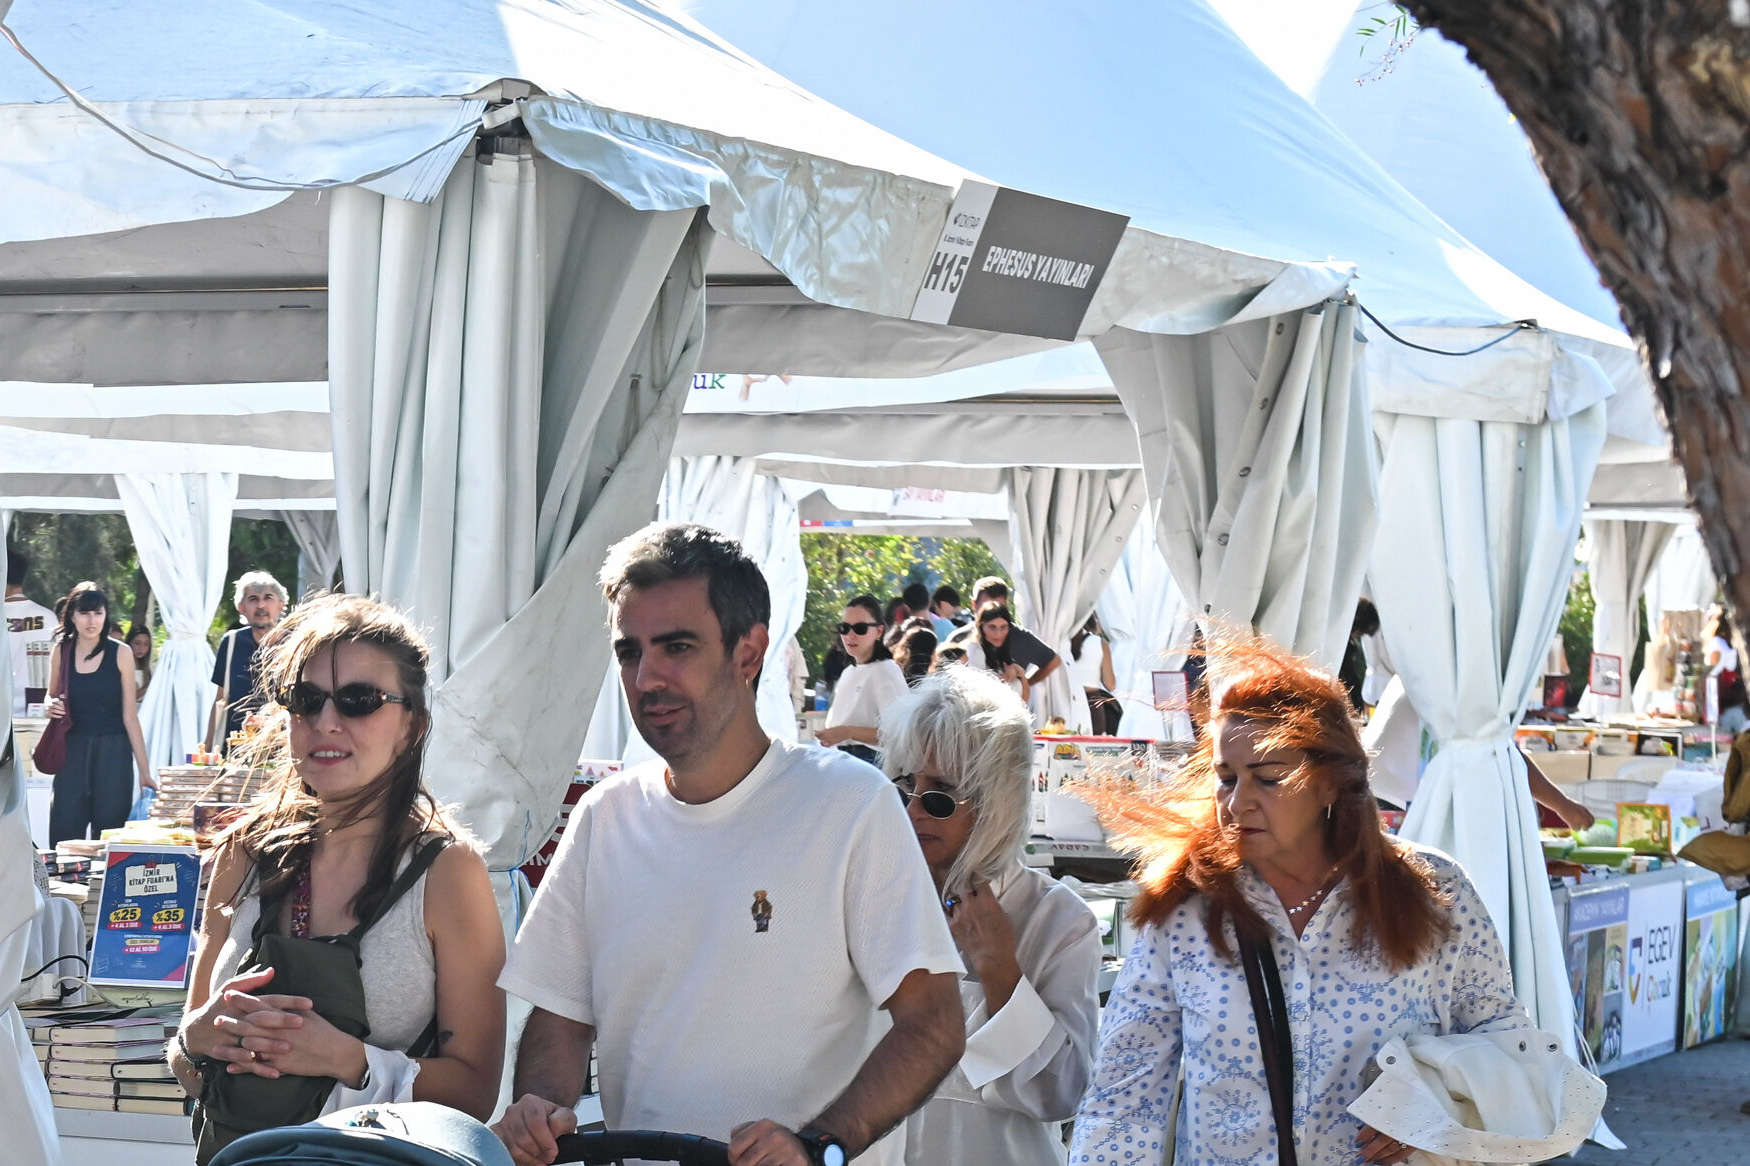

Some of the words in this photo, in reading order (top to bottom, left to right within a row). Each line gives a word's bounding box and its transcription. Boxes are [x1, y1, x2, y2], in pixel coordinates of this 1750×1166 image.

[924, 252, 970, 294] H15
[982, 246, 1037, 281] EPHESUS
[1033, 255, 1095, 289] YAYINLARI
[143, 867, 160, 876] İZMİR
[129, 878, 145, 886] KİTAP
[144, 884, 158, 892] ÖZEL
[113, 908, 137, 921] %25
[156, 910, 180, 922] %35
[1648, 923, 1677, 965] EGEV
